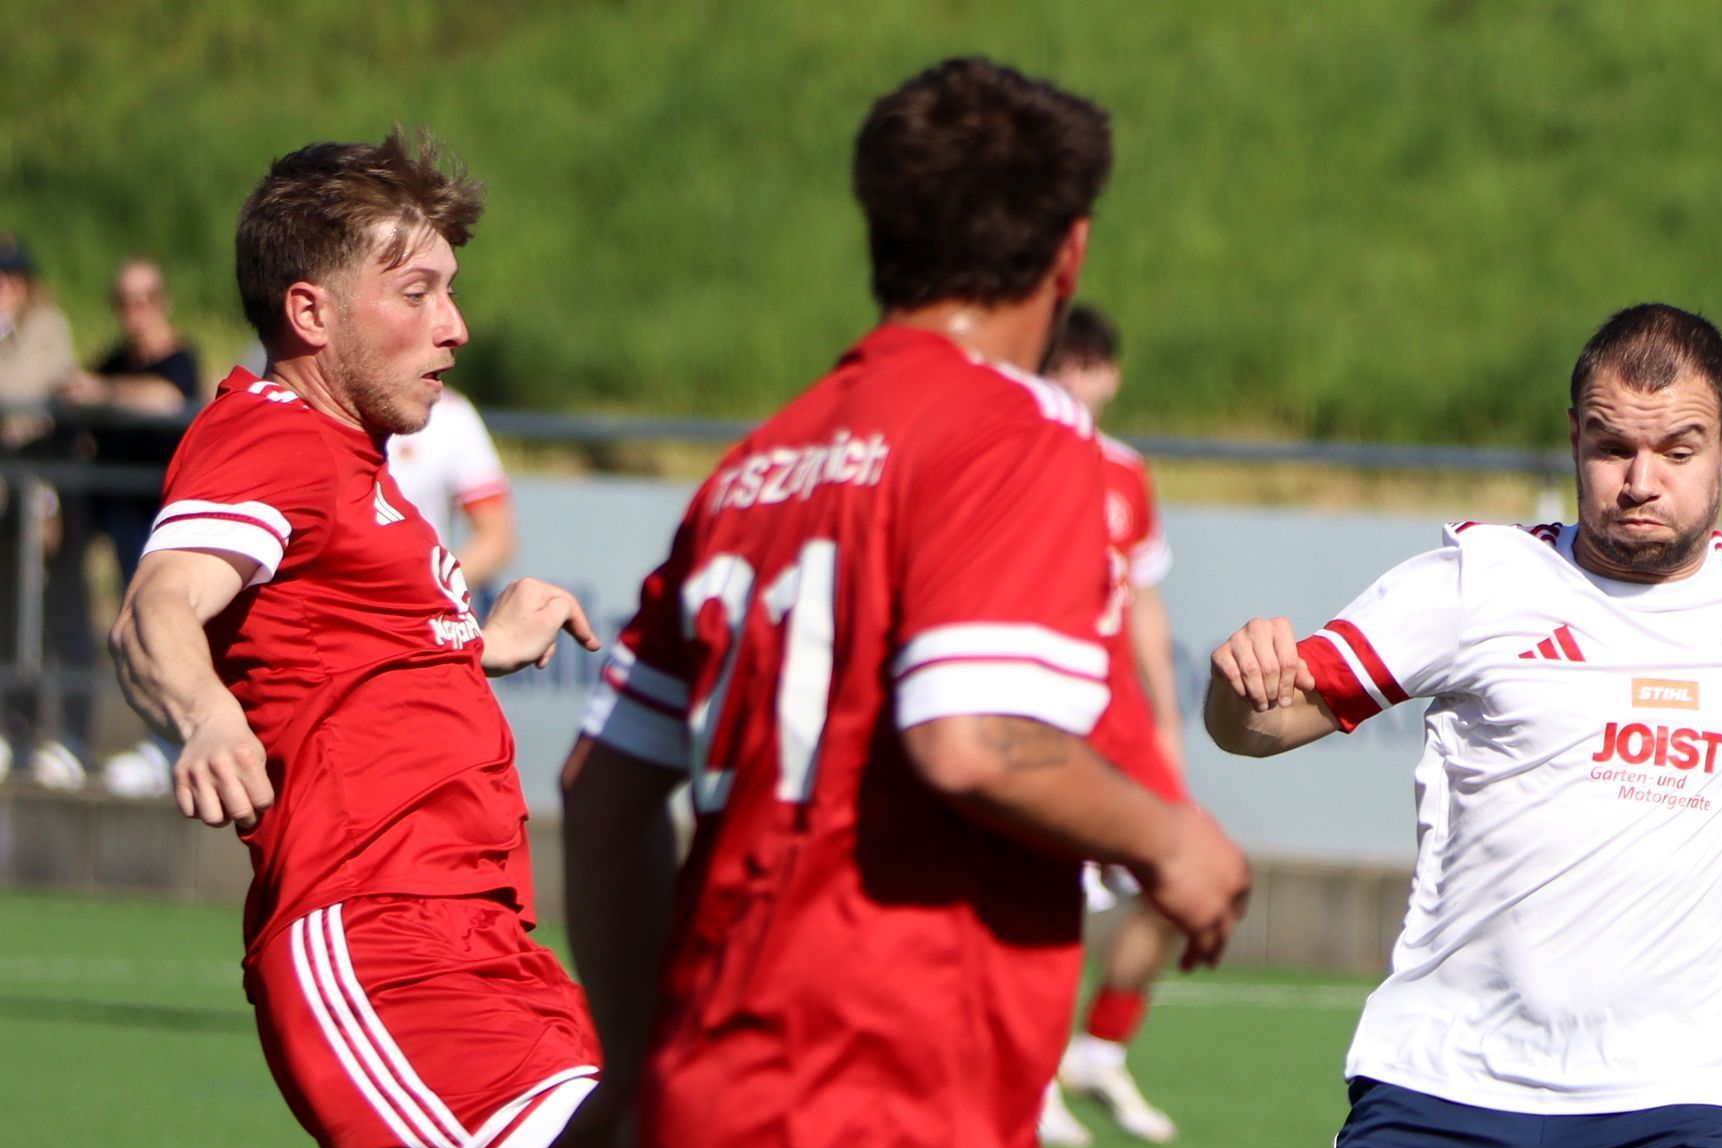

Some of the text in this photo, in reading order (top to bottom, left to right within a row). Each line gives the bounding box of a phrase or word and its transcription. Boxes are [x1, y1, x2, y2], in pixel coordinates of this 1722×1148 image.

[681, 538, 838, 813] 21
[1639, 686, 1693, 702] STIHL
[1656, 775, 1688, 790] und
[1617, 785, 1711, 811] Motorgeräte
